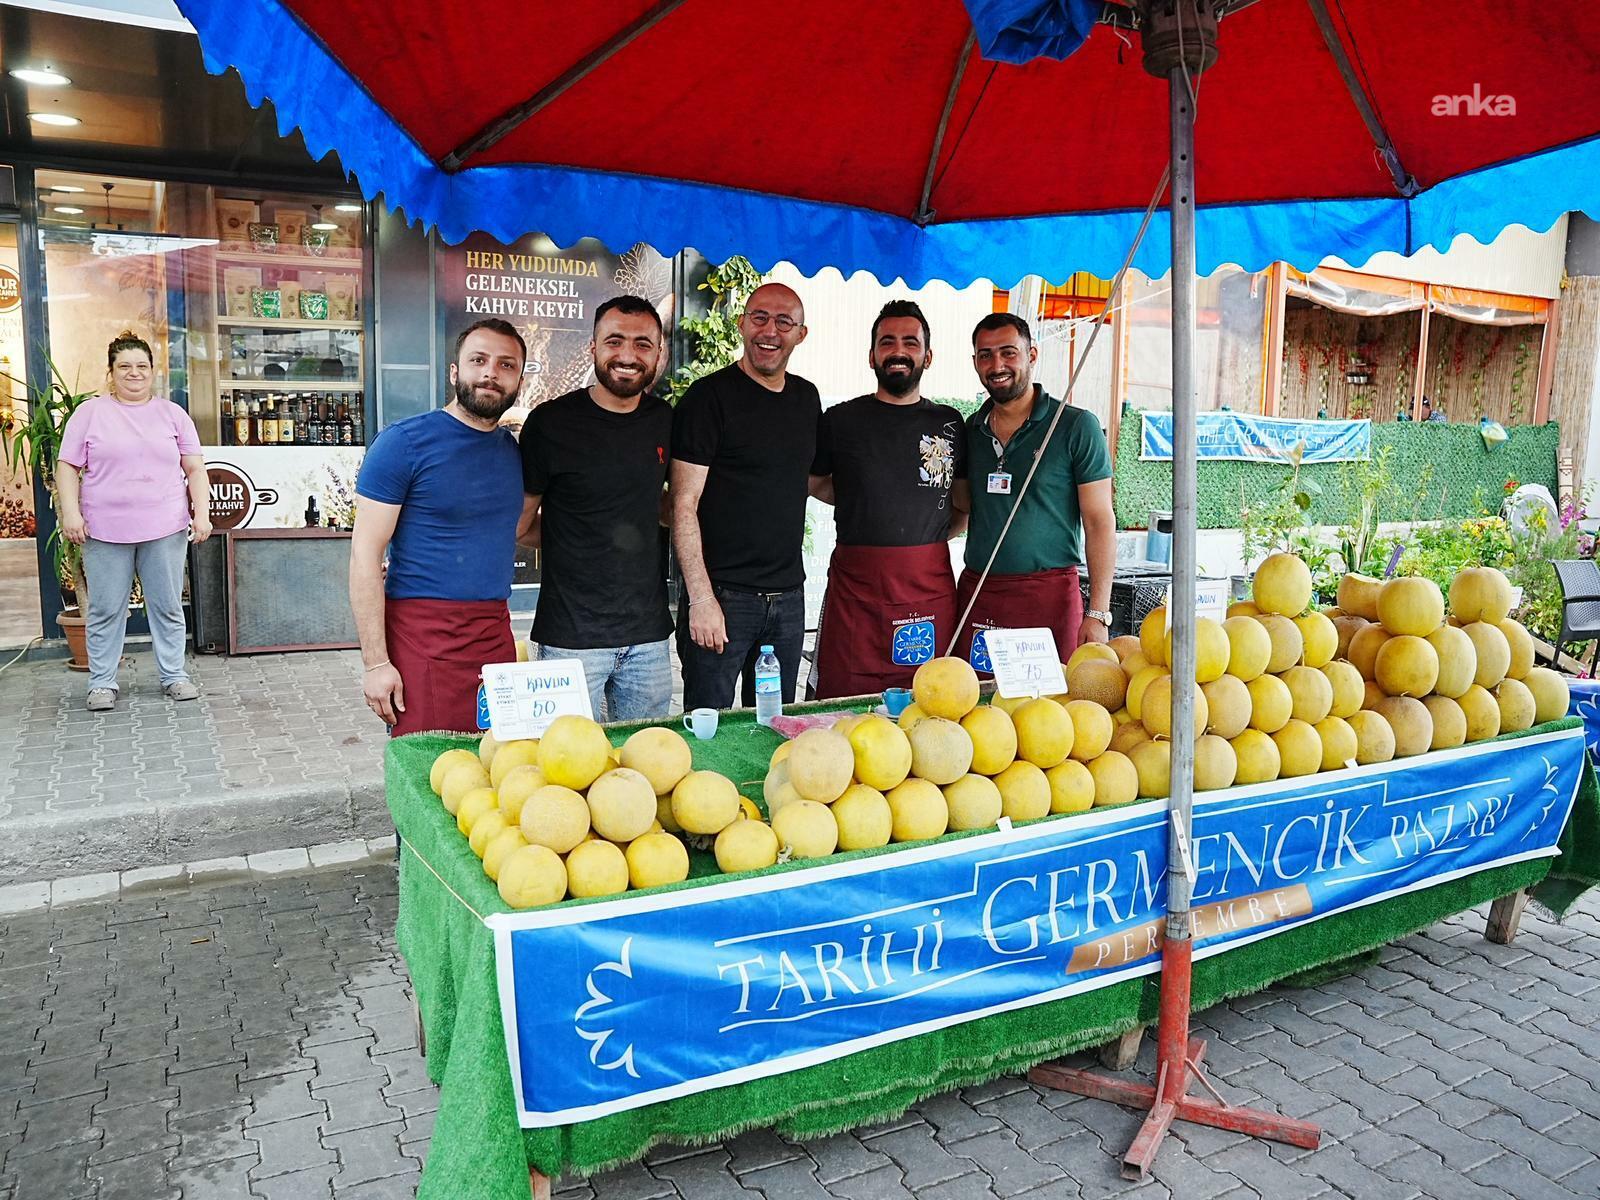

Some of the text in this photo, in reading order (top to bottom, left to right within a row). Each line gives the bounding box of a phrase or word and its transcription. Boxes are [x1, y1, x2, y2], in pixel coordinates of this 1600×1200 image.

[465, 250, 599, 278] HER YUDUMDA
[465, 273, 579, 298] GELENEKSEL
[465, 296, 585, 320] KAHVE KEYFİ
[208, 483, 244, 501] NUR
[215, 501, 245, 510] KAHVE
[1196, 594, 1216, 605] AVUN
[526, 676, 570, 693] KAVUN
[714, 792, 1516, 1016] TARİHİ GERMENCİK PAZARI
[1094, 892, 1293, 967] PEREMBE
